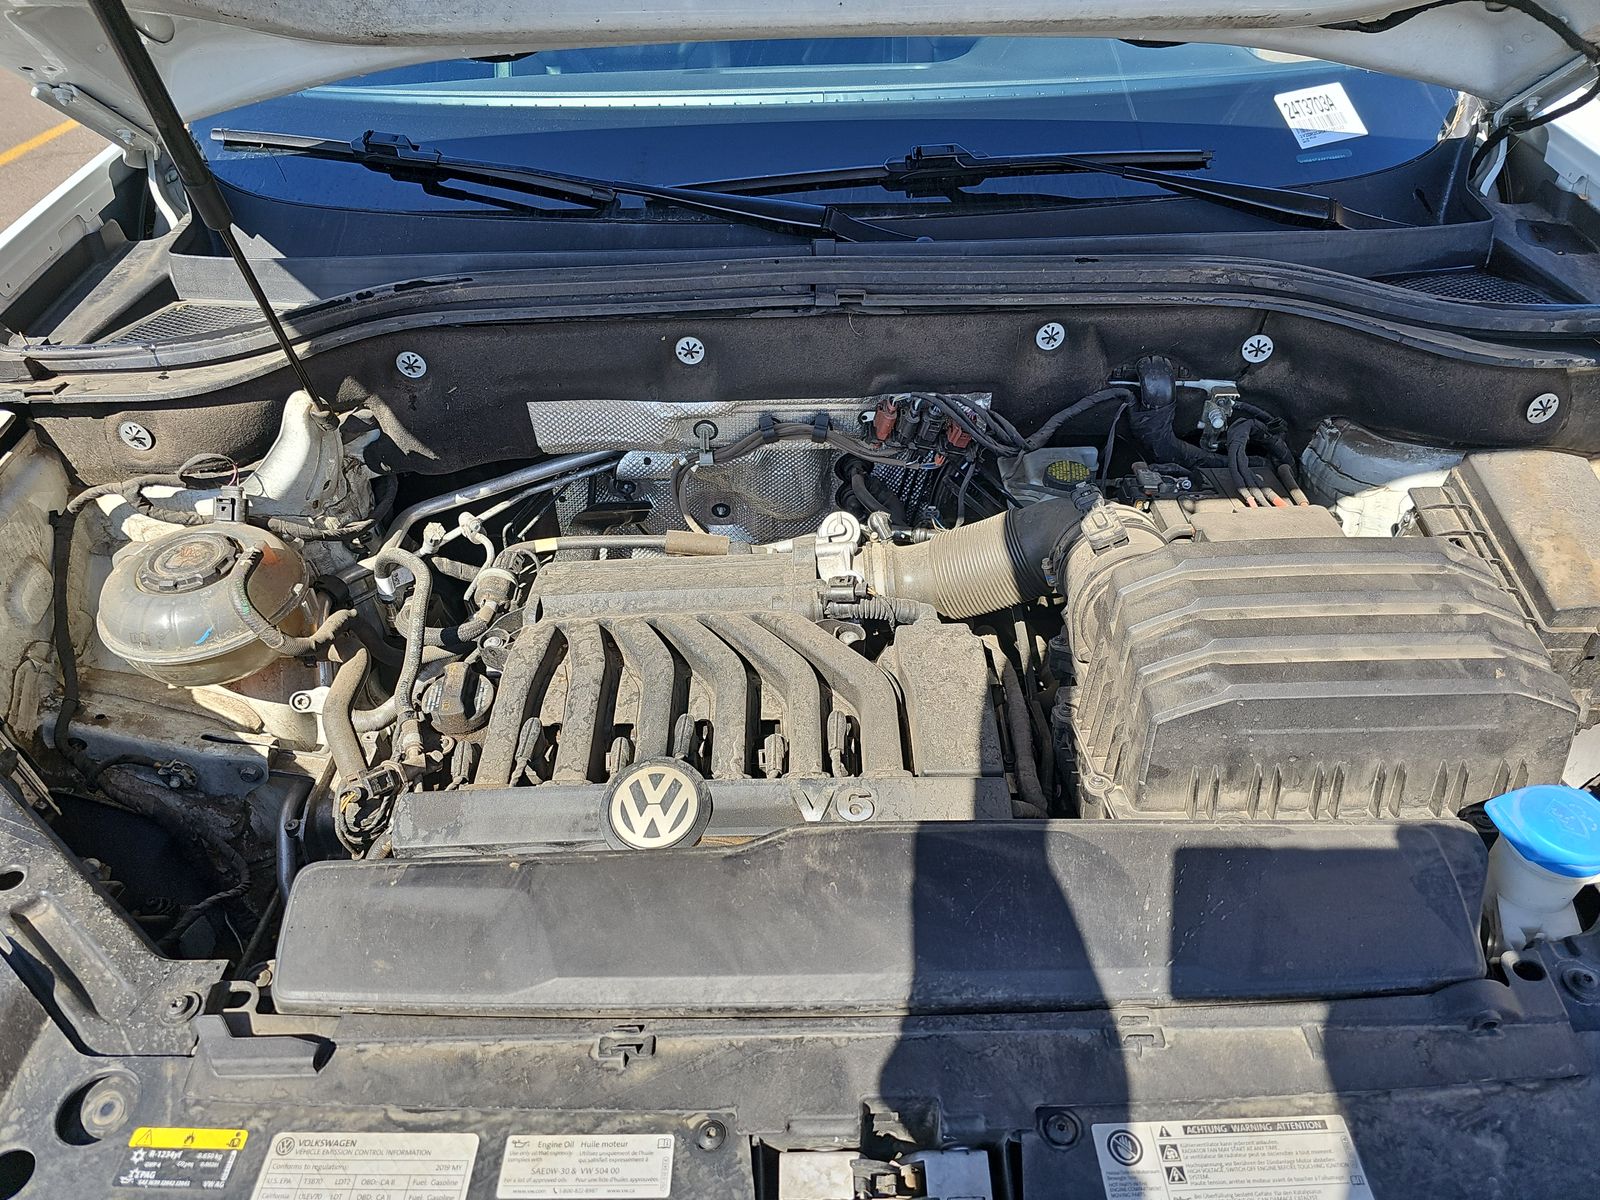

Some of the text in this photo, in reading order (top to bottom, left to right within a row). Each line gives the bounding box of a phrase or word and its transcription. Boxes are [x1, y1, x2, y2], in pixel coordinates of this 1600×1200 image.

[1284, 94, 1337, 119] 24T3703A
[793, 788, 875, 823] V6
[1186, 1121, 1322, 1134] ACHTUNG WARNING ATTENTION
[298, 1139, 358, 1148] VOLKSWAGEN
[537, 1141, 563, 1150] Engine
[148, 1150, 183, 1160] R-1234yf
[354, 1148, 384, 1156] CONTROL
